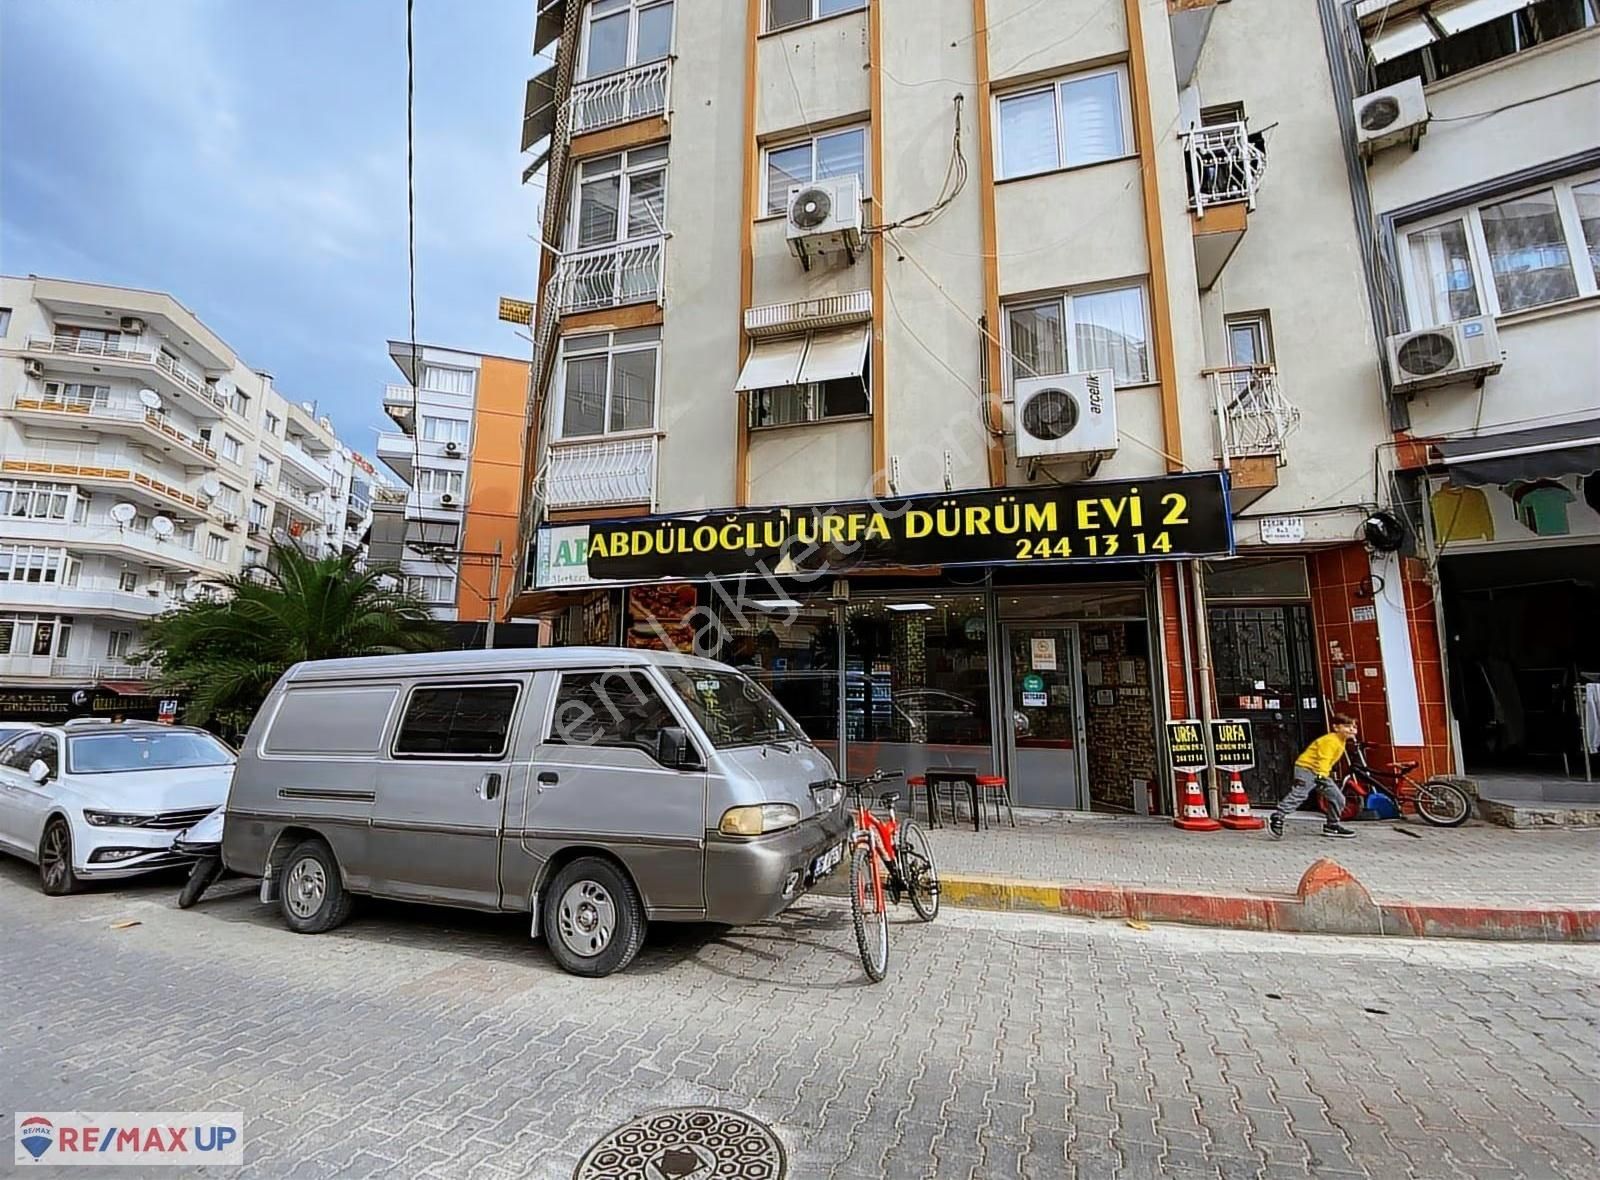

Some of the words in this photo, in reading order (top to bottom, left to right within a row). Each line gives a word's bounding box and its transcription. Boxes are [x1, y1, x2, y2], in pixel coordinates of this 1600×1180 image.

[588, 513, 785, 559] ABDÜLOĞLU
[797, 512, 891, 543] URFA
[905, 496, 1057, 539] DÜRÜM
[1076, 487, 1143, 530] EVİ
[1160, 493, 1189, 525] 2
[1015, 537, 1072, 560] 244
[1084, 533, 1119, 556] 13
[1133, 531, 1172, 555] 14
[1173, 725, 1199, 742] URFA
[1218, 724, 1246, 742] URFA
